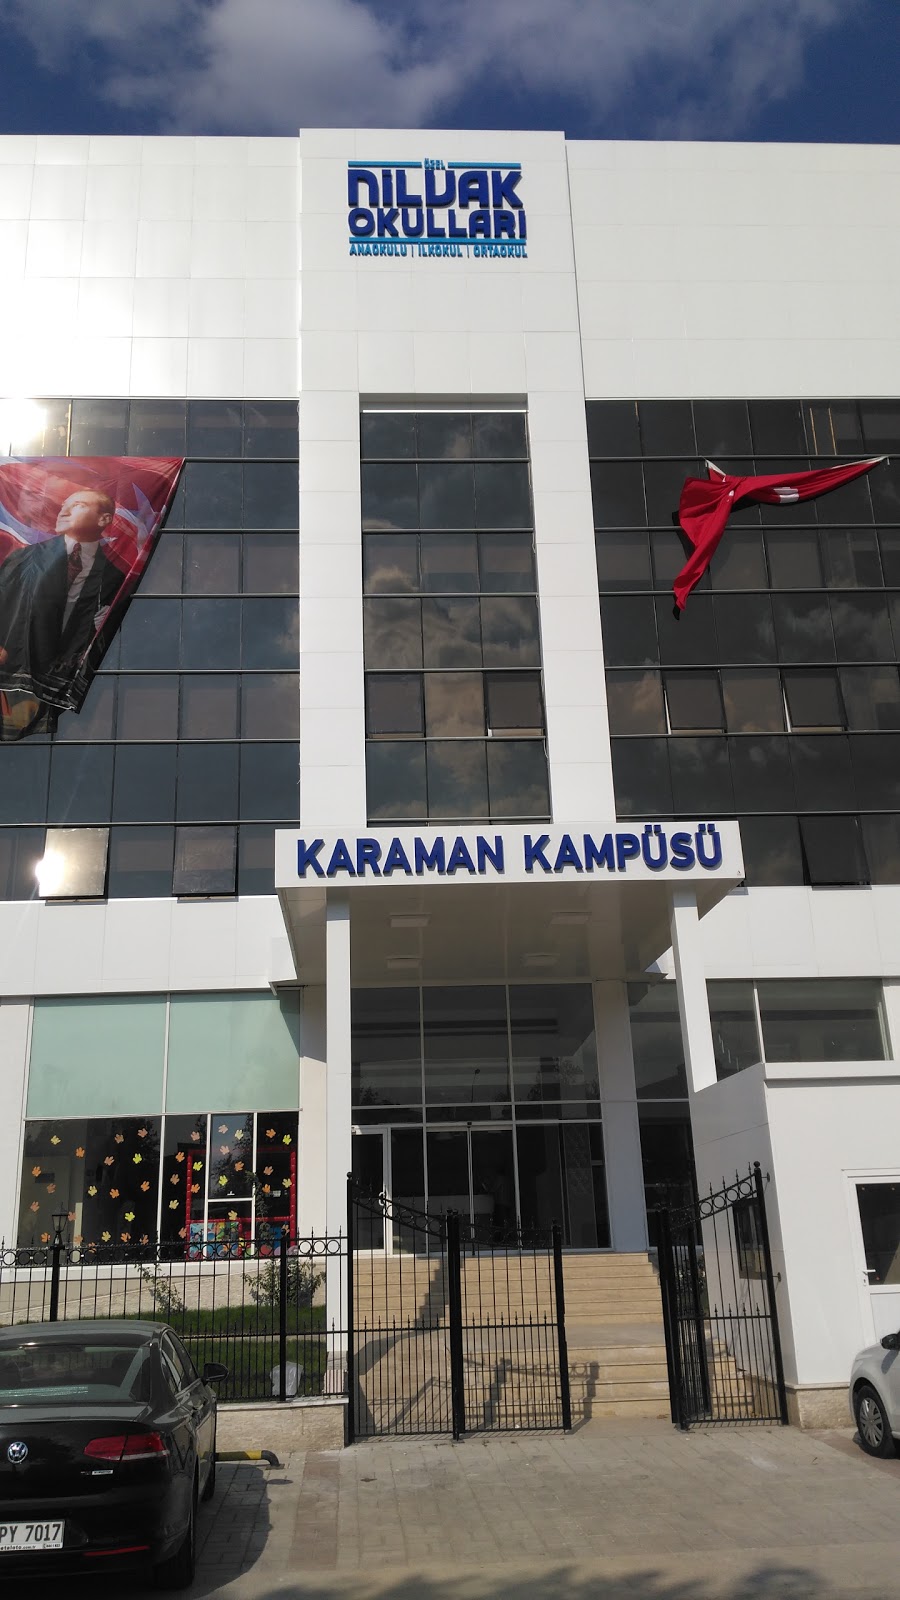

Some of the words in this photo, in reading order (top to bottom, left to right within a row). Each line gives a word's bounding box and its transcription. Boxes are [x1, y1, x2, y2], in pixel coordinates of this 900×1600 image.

[348, 207, 527, 239] OKULLARI
[349, 243, 407, 257] ANAOKULU
[418, 242, 463, 258] İLKOKUL
[473, 245, 528, 259] ORTAOKUL
[298, 836, 504, 878] KARAMAN
[524, 824, 721, 872] KAMPÜSÜ
[0, 1525, 18, 1543] PY
[25, 1523, 61, 1542] 7017
